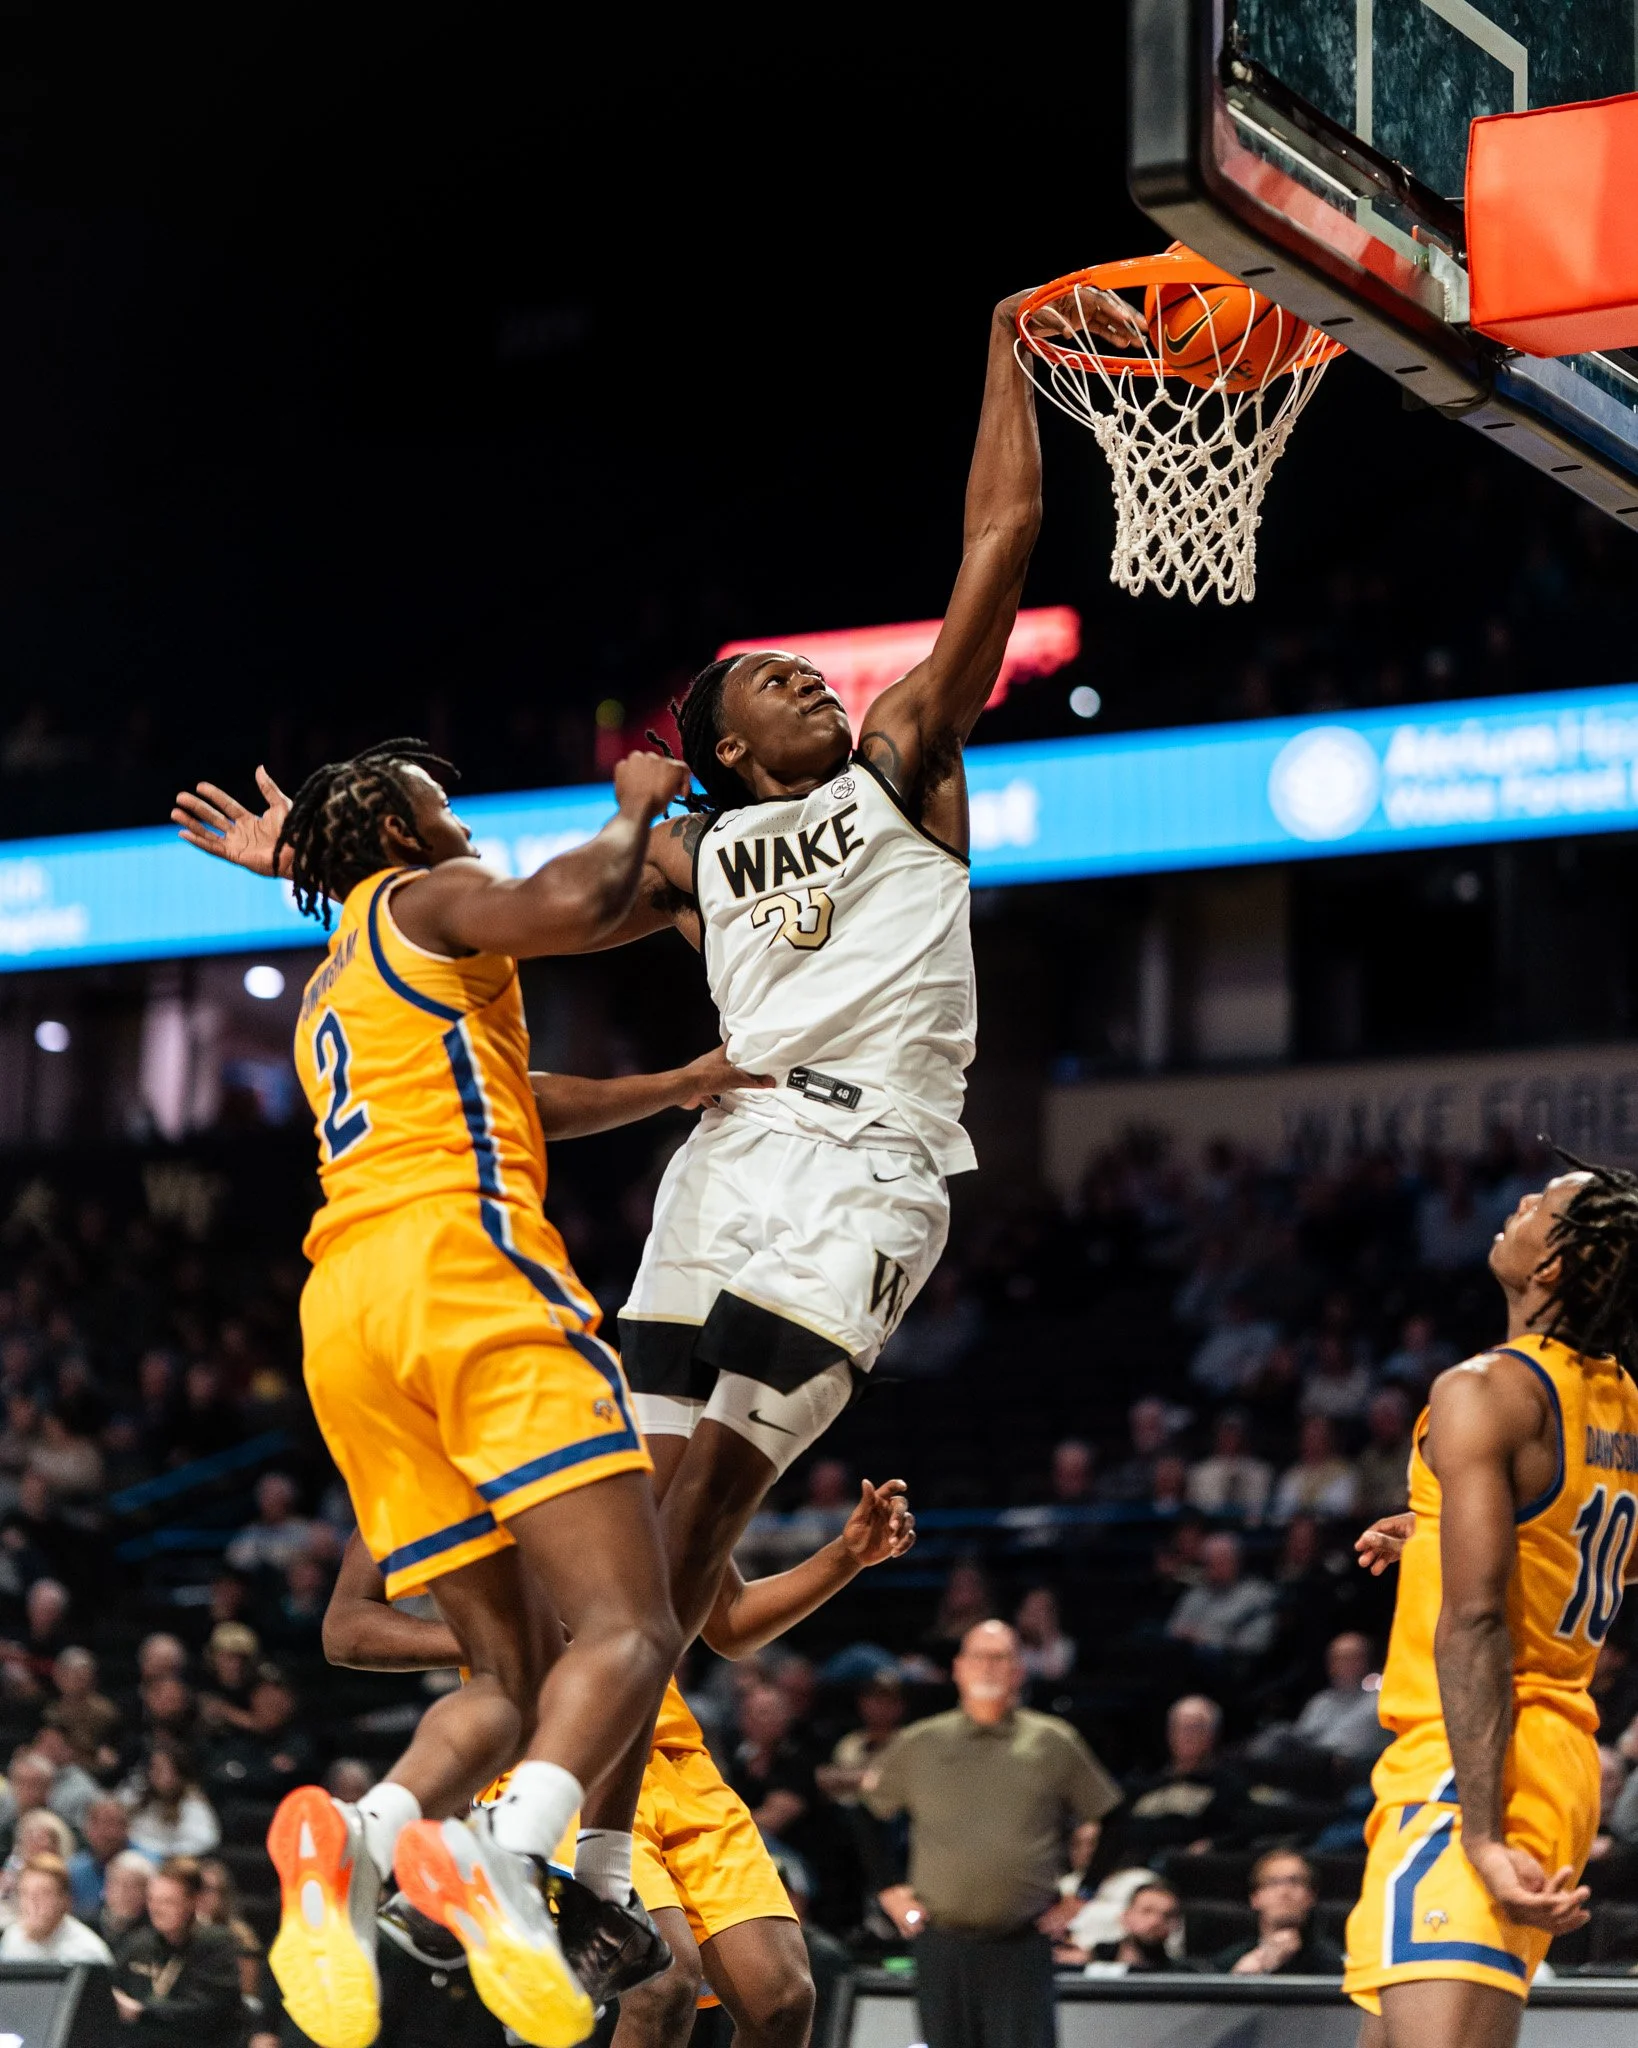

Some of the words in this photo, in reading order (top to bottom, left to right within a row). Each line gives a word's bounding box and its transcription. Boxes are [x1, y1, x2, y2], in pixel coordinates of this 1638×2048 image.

[716, 802, 865, 899] WAKE
[313, 1005, 372, 1163] 2
[836, 1088, 850, 1100] 48
[1555, 1483, 1638, 1647] 10
